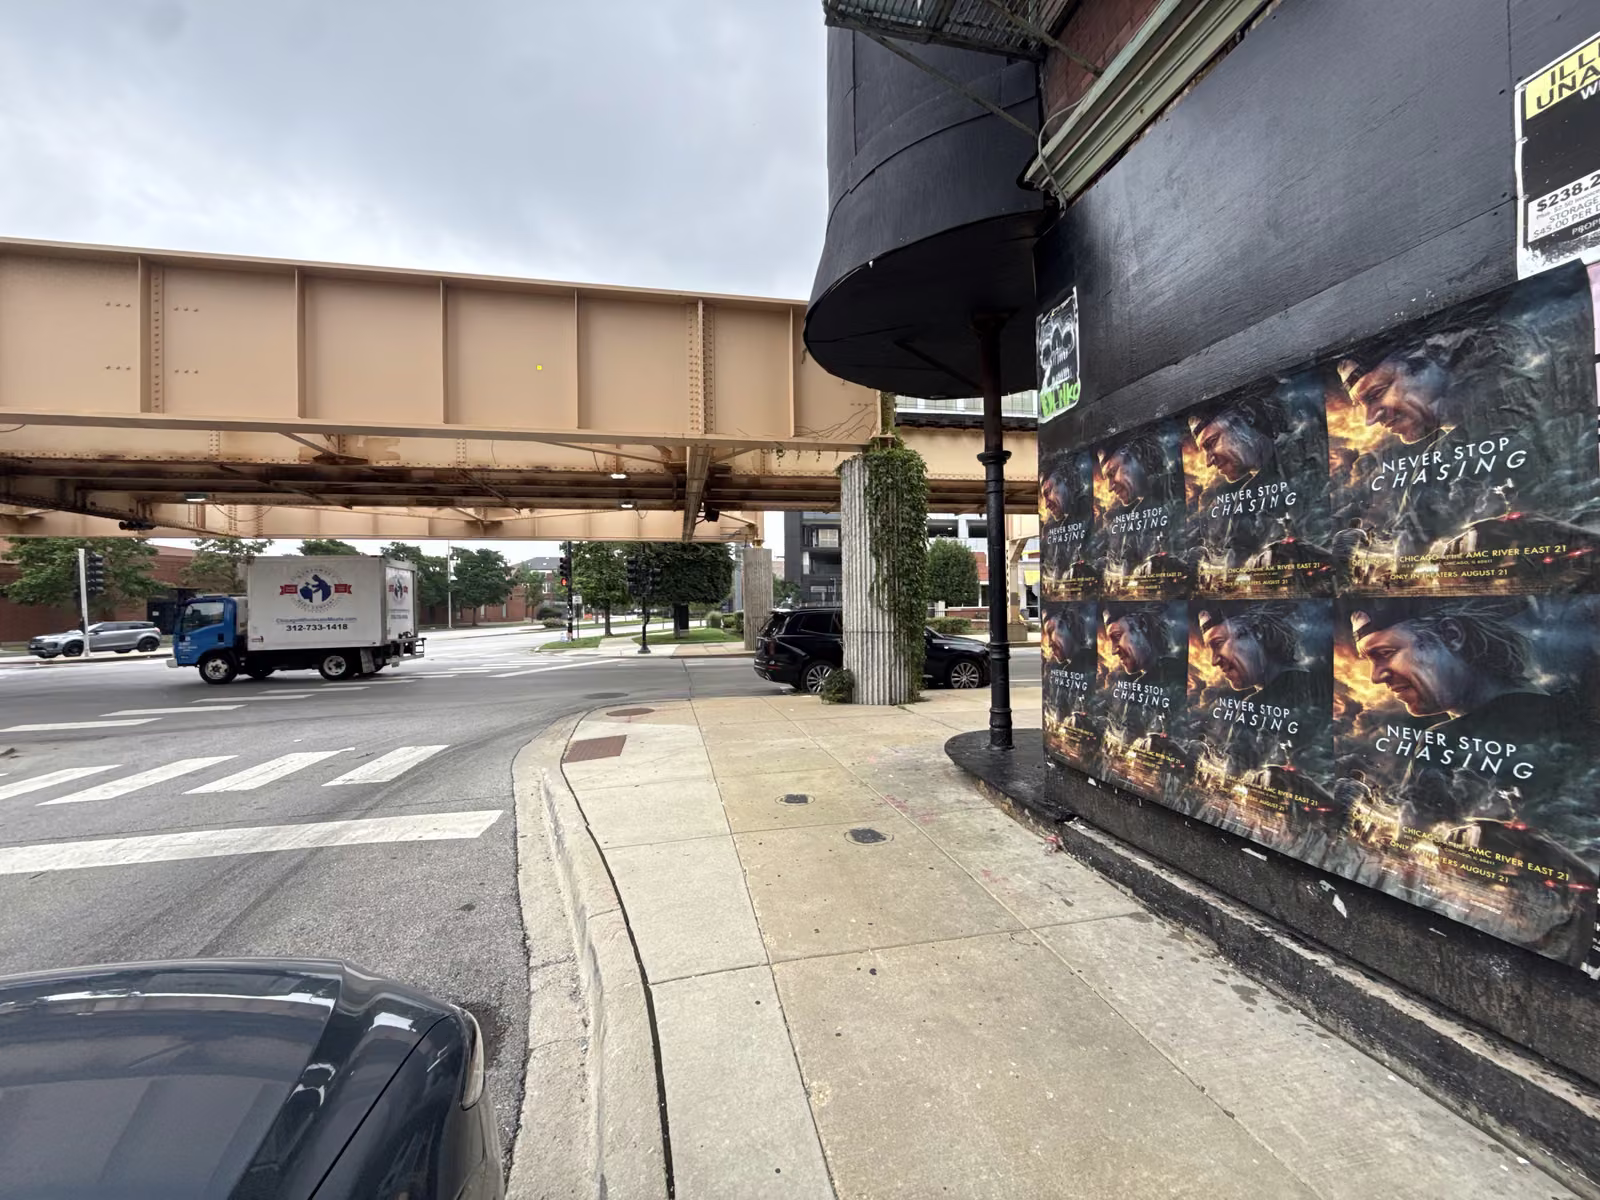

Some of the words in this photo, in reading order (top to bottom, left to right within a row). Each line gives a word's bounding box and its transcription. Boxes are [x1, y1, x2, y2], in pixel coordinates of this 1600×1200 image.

[1551, 42, 1600, 86] ILL
[1549, 195, 1600, 223] STORAGE
[1533, 217, 1569, 239] $45.00
[1571, 208, 1592, 222] PER
[1571, 217, 1600, 236] PROP
[1382, 451, 1442, 473] NEVER
[1454, 437, 1509, 460] STOP
[1371, 450, 1528, 491] CHASING
[1216, 489, 1252, 504] NEVER
[1257, 481, 1288, 497] STOP
[1115, 511, 1140, 523] NEVER
[1142, 507, 1163, 518] STOP
[1211, 491, 1297, 518] CHASING
[1111, 515, 1168, 534] CHASING
[1047, 529, 1086, 545] CHASING
[1399, 553, 1439, 563] CHICAGO
[1466, 550, 1490, 559] AMC
[1492, 548, 1520, 557] RIVER
[1523, 545, 1551, 555] EAST
[1554, 544, 1567, 553] 21
[1461, 568, 1496, 577] AUGUST
[1498, 568, 1508, 576] 21
[286, 623, 348, 632] 312-733-1418
[1113, 688, 1170, 708] CHASING
[1117, 680, 1142, 692] NEVER
[1144, 684, 1164, 696] STOP
[1219, 697, 1254, 712] NEVER
[1260, 704, 1290, 718] STOP
[1212, 707, 1299, 734] CHASING
[1387, 724, 1447, 747] NEVER
[1458, 736, 1516, 757] STOP
[1375, 737, 1534, 779] CHASING
[1402, 826, 1441, 843] CHICAGO
[1468, 846, 1493, 859] AMC
[1495, 853, 1524, 868] RIVER
[1527, 862, 1554, 876] EAST
[1557, 871, 1569, 881] 21
[1459, 863, 1496, 879] AUGUST
[1499, 875, 1509, 884] 21
